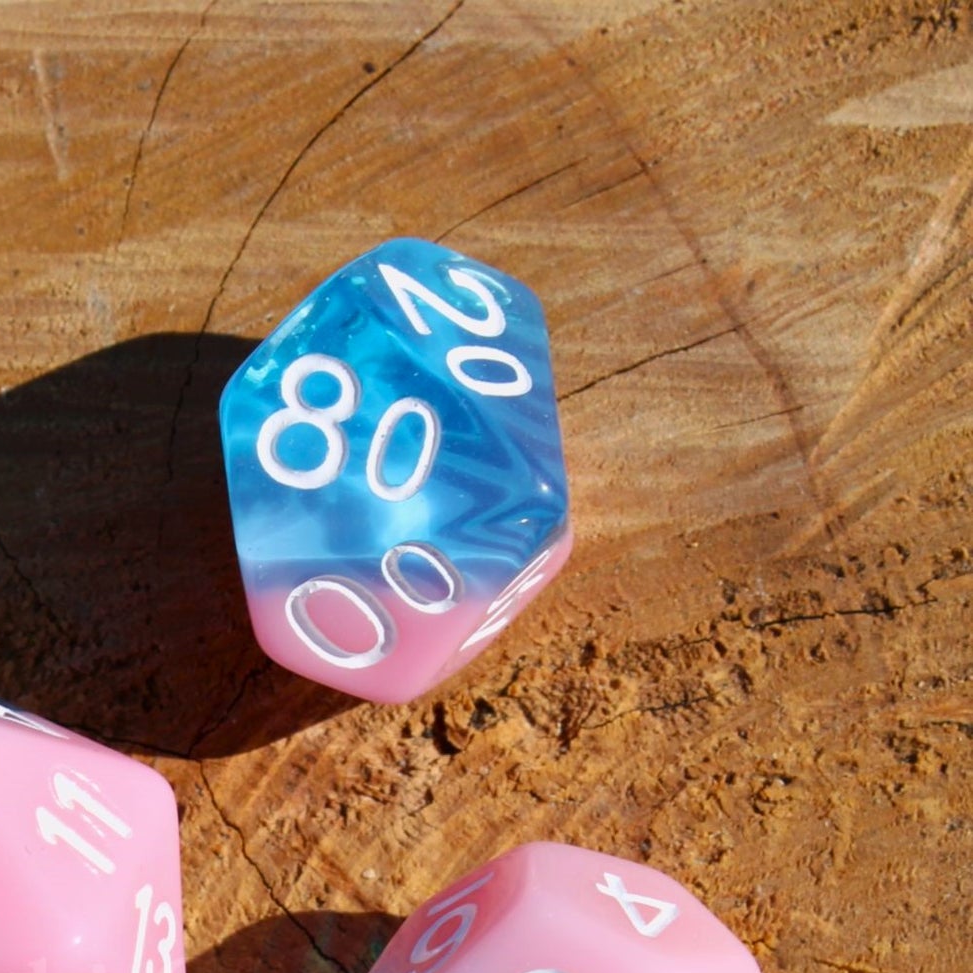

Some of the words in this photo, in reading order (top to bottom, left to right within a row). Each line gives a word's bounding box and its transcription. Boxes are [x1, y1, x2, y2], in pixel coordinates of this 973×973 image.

[378, 263, 532, 397] 20
[256, 353, 441, 501] 80
[35, 770, 133, 875] 11
[596, 872, 680, 937] 4
